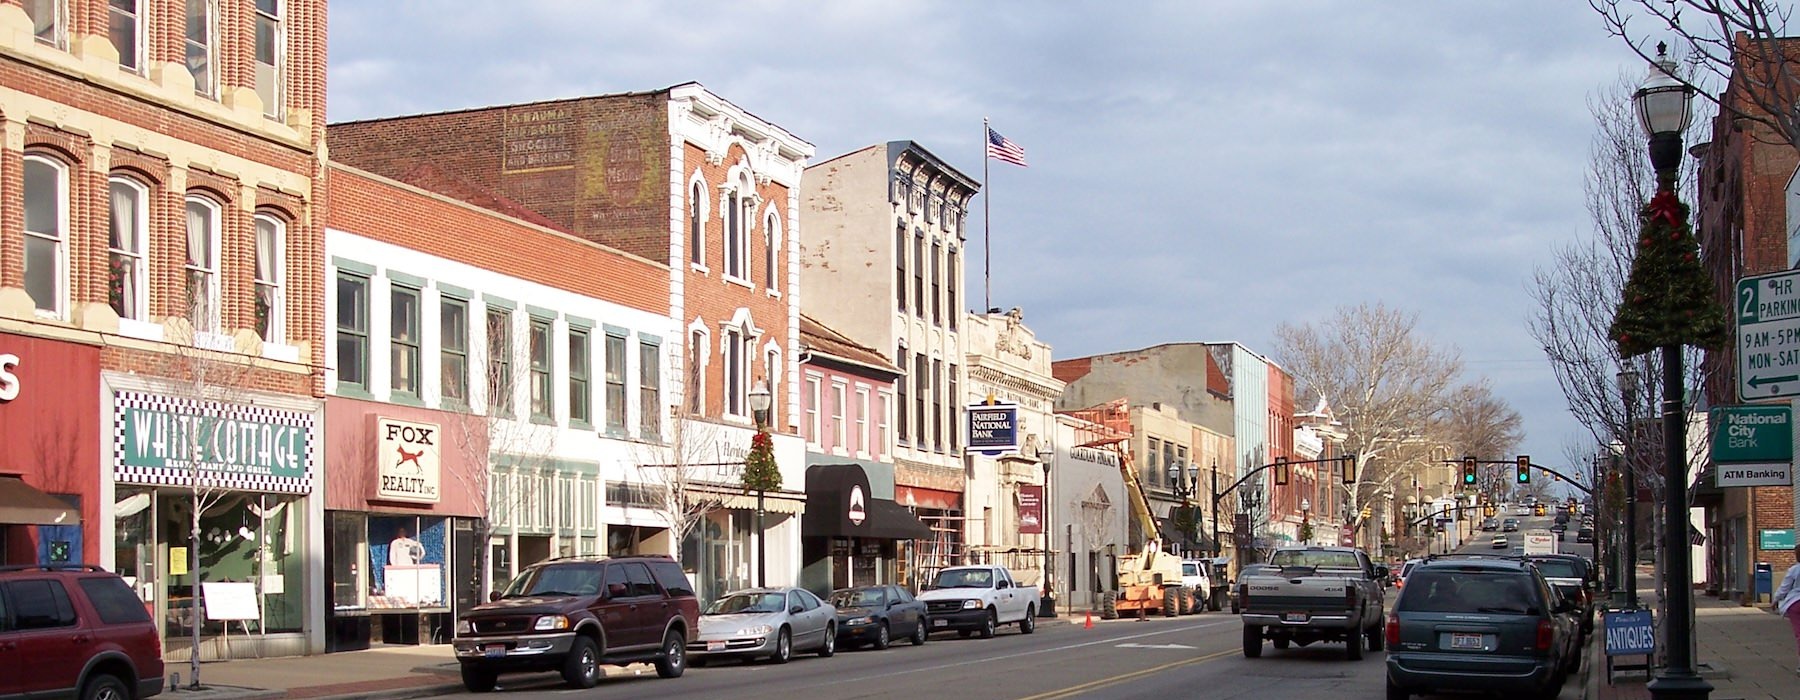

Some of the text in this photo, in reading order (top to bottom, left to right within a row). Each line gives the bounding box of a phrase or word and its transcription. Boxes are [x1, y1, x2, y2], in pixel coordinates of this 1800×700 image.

[1742, 279, 1793, 318] 2 HR
[972, 412, 1007, 421] FAIRFIELD
[1728, 413, 1786, 425] National
[972, 421, 1012, 430] NATIONAL
[1728, 424, 1756, 438] City
[133, 410, 299, 469] WHITE COTTAGE
[386, 423, 433, 446] FOX
[972, 430, 994, 439] BANK
[1728, 437, 1758, 448] Bank
[247, 465, 272, 474] GRILL
[1724, 470, 1785, 480] ATM Banking
[382, 475, 425, 493] REALTY
[1606, 625, 1655, 650] ANTIQUES
